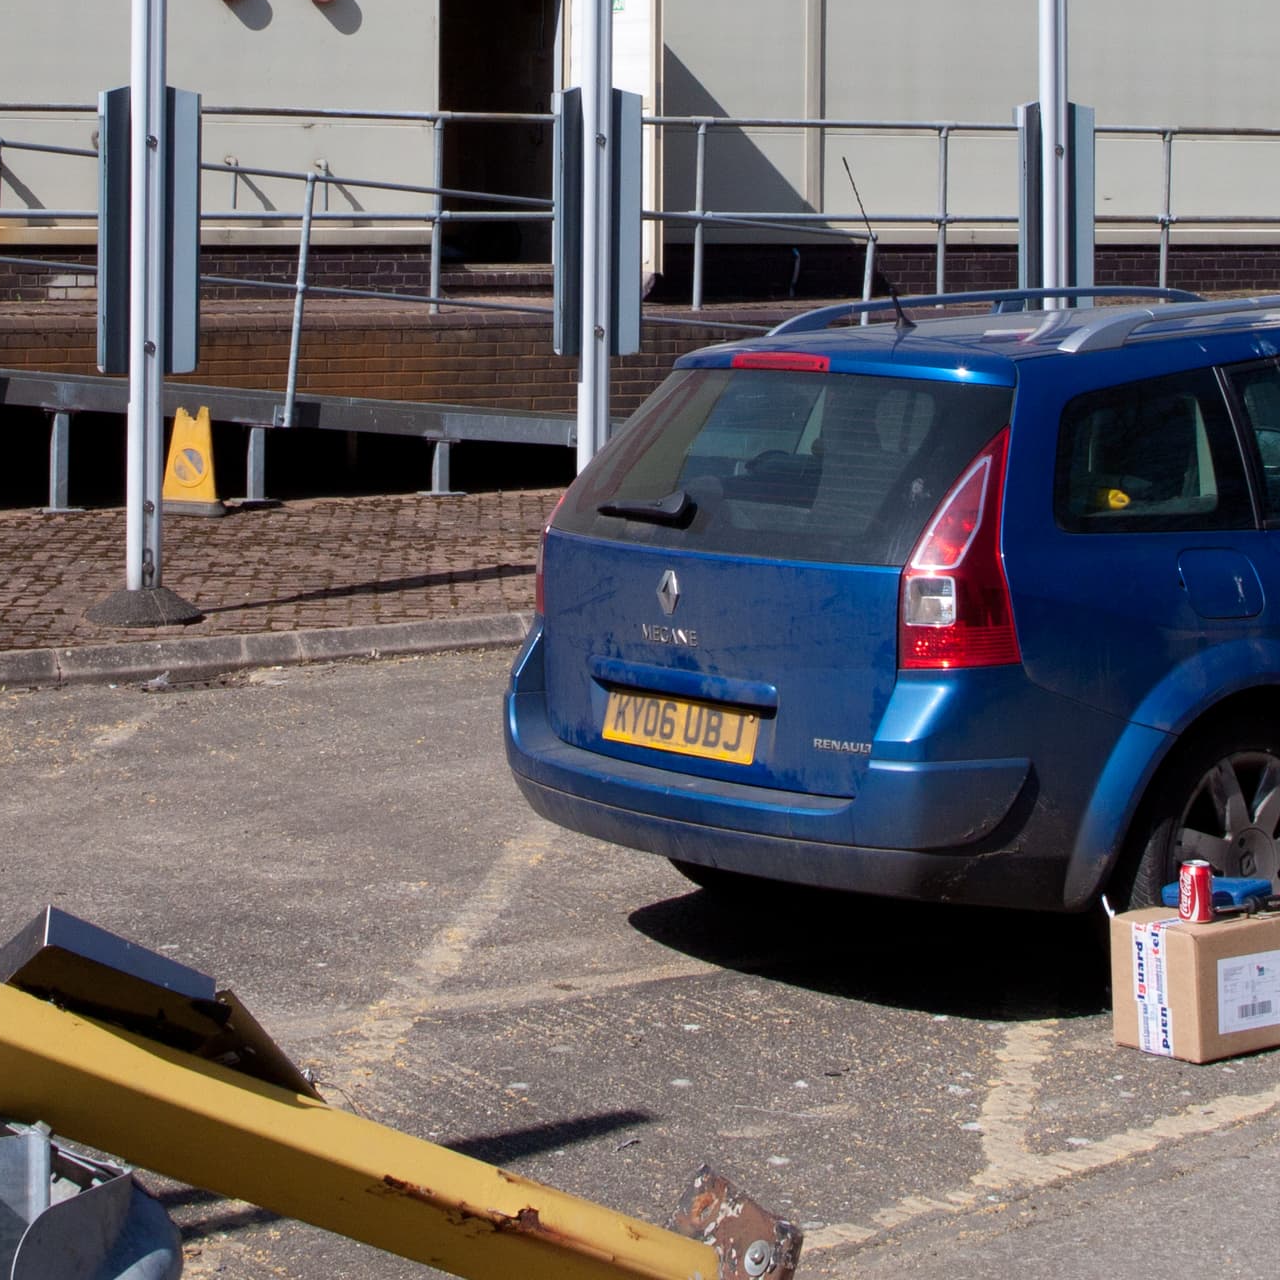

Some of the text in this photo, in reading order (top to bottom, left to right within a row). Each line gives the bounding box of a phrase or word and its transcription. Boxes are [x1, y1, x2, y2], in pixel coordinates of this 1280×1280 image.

[614, 695, 745, 752] KY06 UBJ
[813, 738, 872, 754] RENAULT
